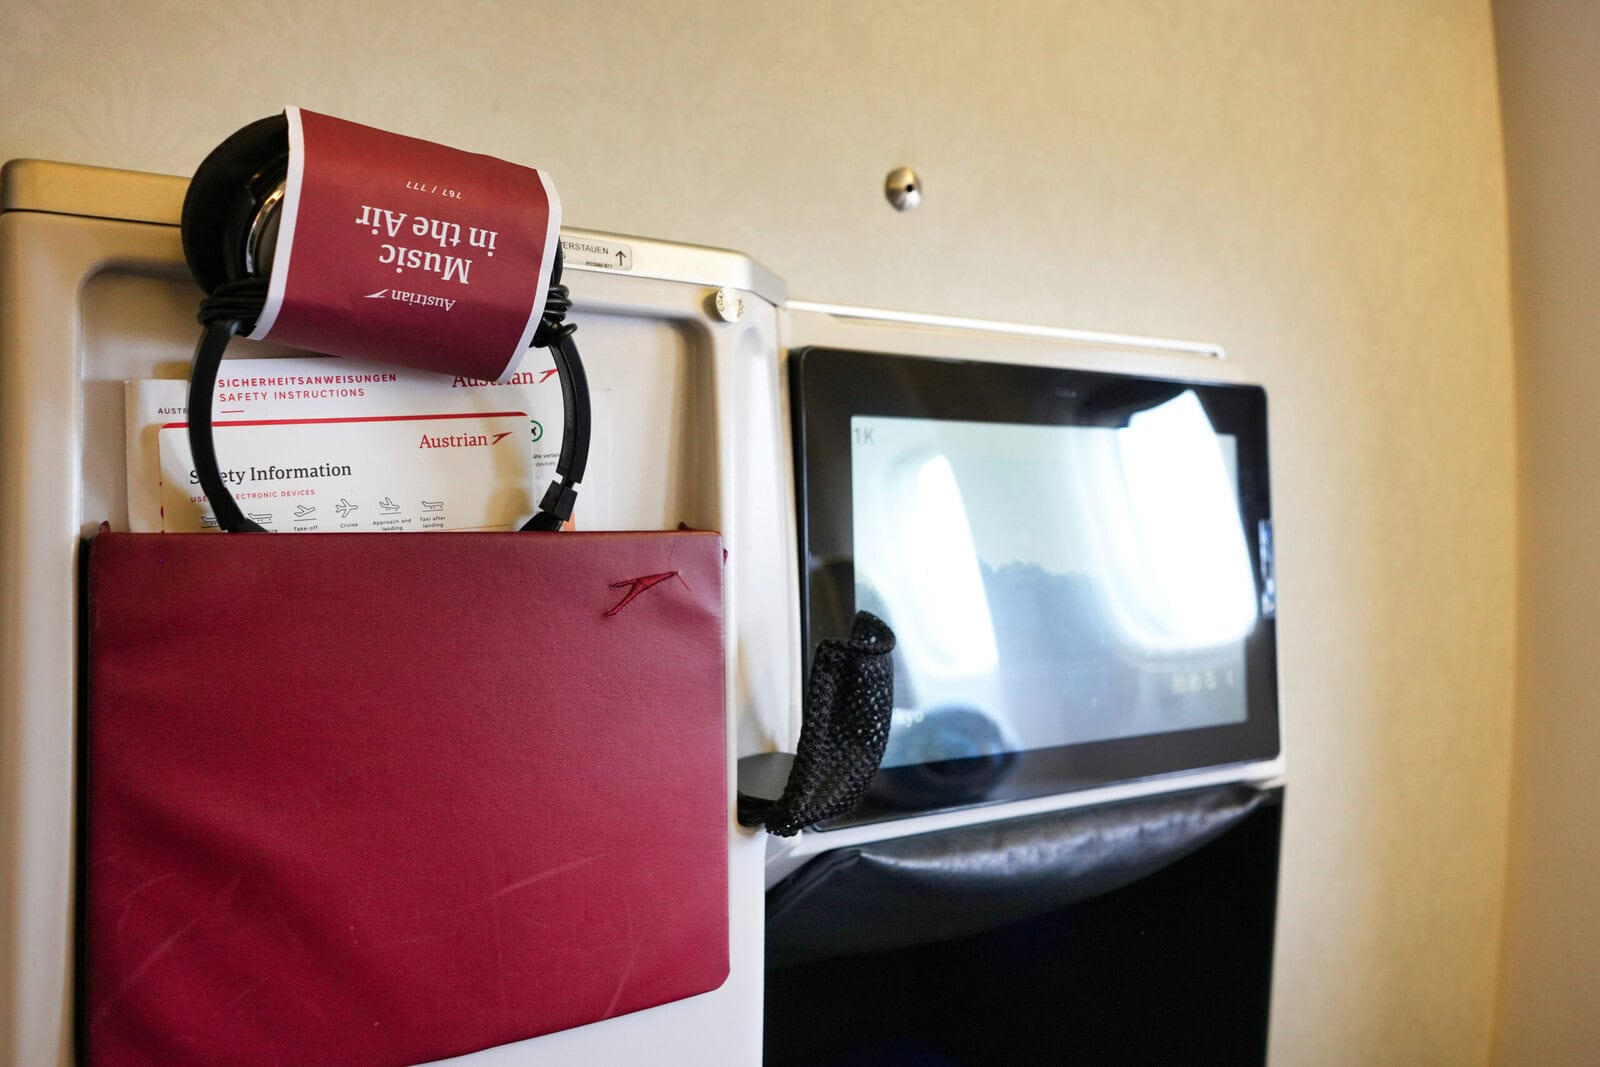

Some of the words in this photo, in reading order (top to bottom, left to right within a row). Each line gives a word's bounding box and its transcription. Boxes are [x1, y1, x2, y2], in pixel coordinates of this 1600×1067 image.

[406, 180, 426, 192] 777
[442, 188, 462, 200] 767
[355, 205, 407, 238] Air
[412, 216, 461, 248] the
[469, 226, 498, 257] in
[378, 244, 472, 284] Music
[391, 289, 456, 312] Austrian
[218, 373, 397, 388] SICHERHEITSANWEISUNGEN
[219, 391, 268, 402] SAFETY
[274, 388, 365, 400] INSTRUCTIONS
[418, 433, 489, 449] Austrian
[854, 427, 876, 445] 1K
[190, 469, 246, 485] Sety
[250, 463, 352, 481] Information
[236, 491, 278, 500] ECTRONIC
[281, 489, 316, 497] DEVICES
